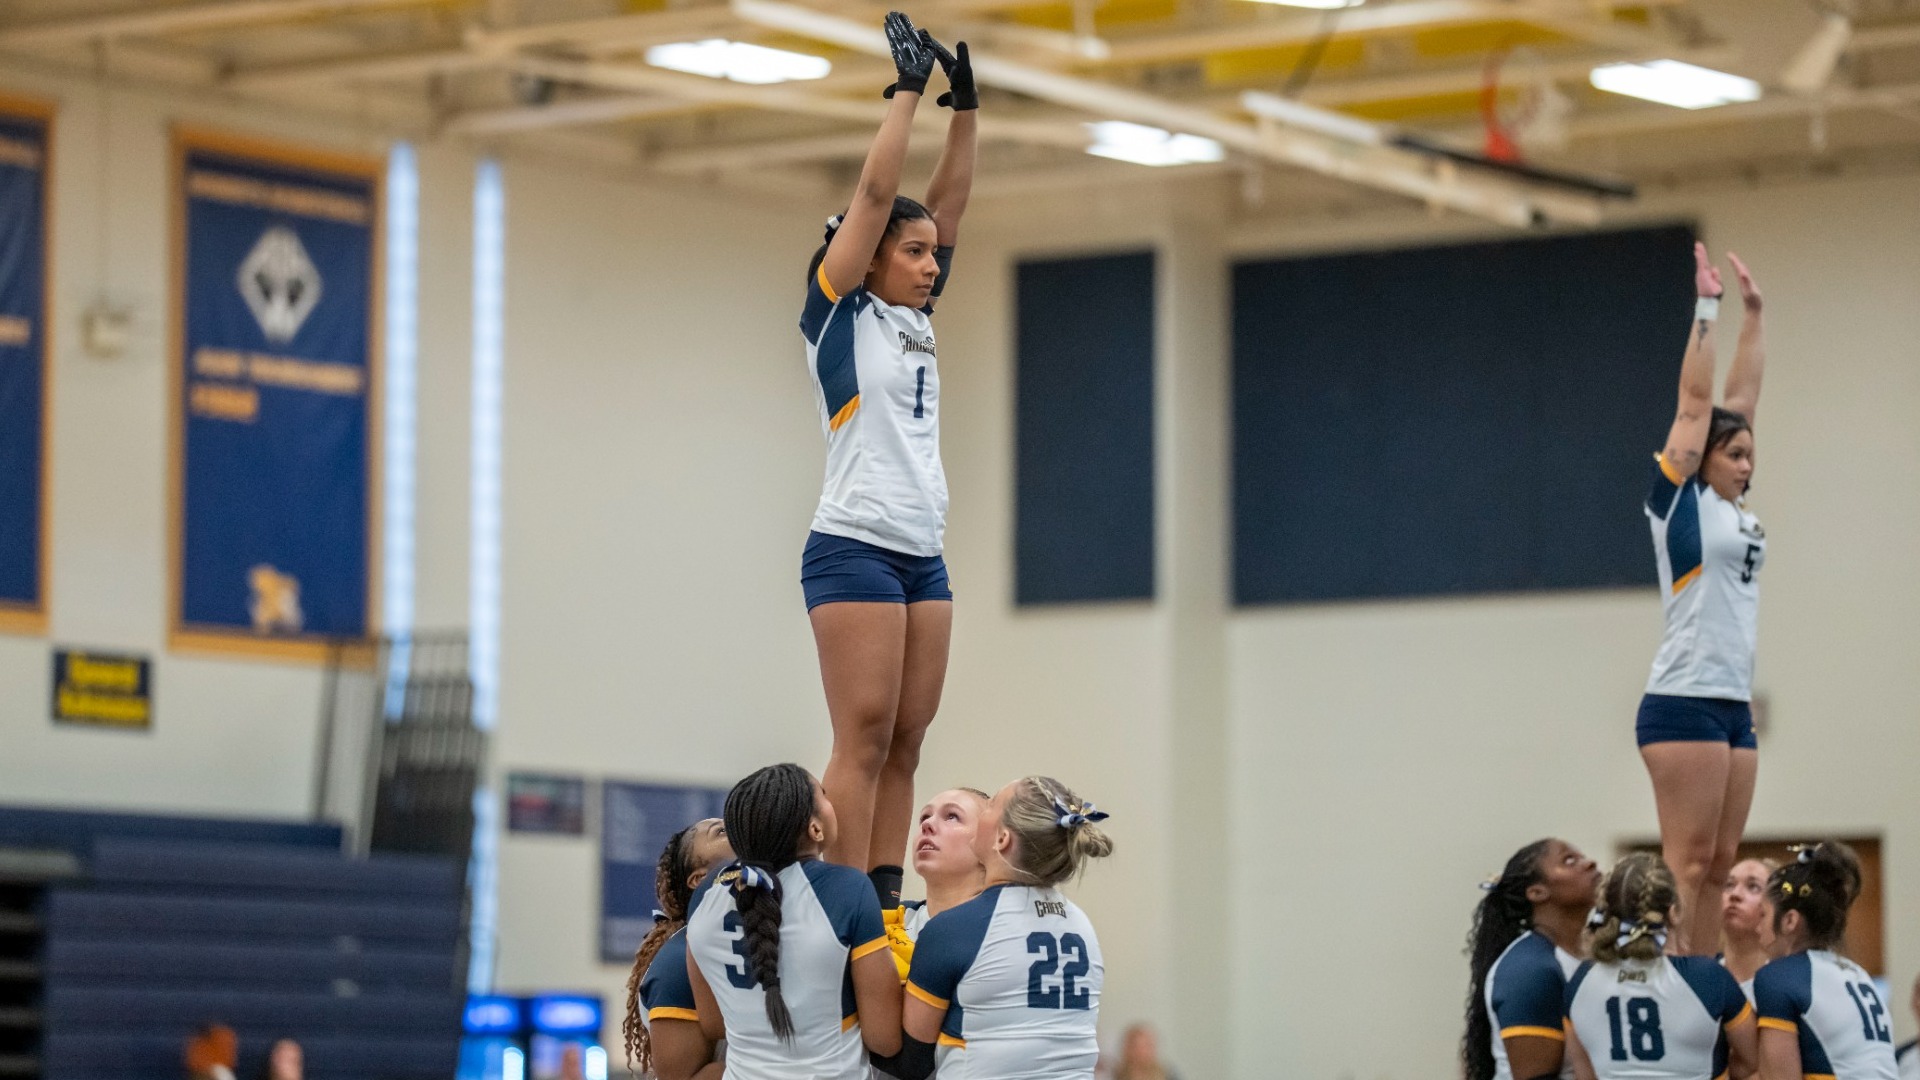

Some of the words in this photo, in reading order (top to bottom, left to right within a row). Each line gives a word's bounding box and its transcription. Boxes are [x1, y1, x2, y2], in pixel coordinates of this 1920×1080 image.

[913, 366, 925, 418] 1
[1741, 544, 1761, 584] 5
[723, 909, 761, 990] 3
[1026, 931, 1090, 1010] 22
[1606, 996, 1666, 1062] 18
[1845, 981, 1892, 1043] 12
